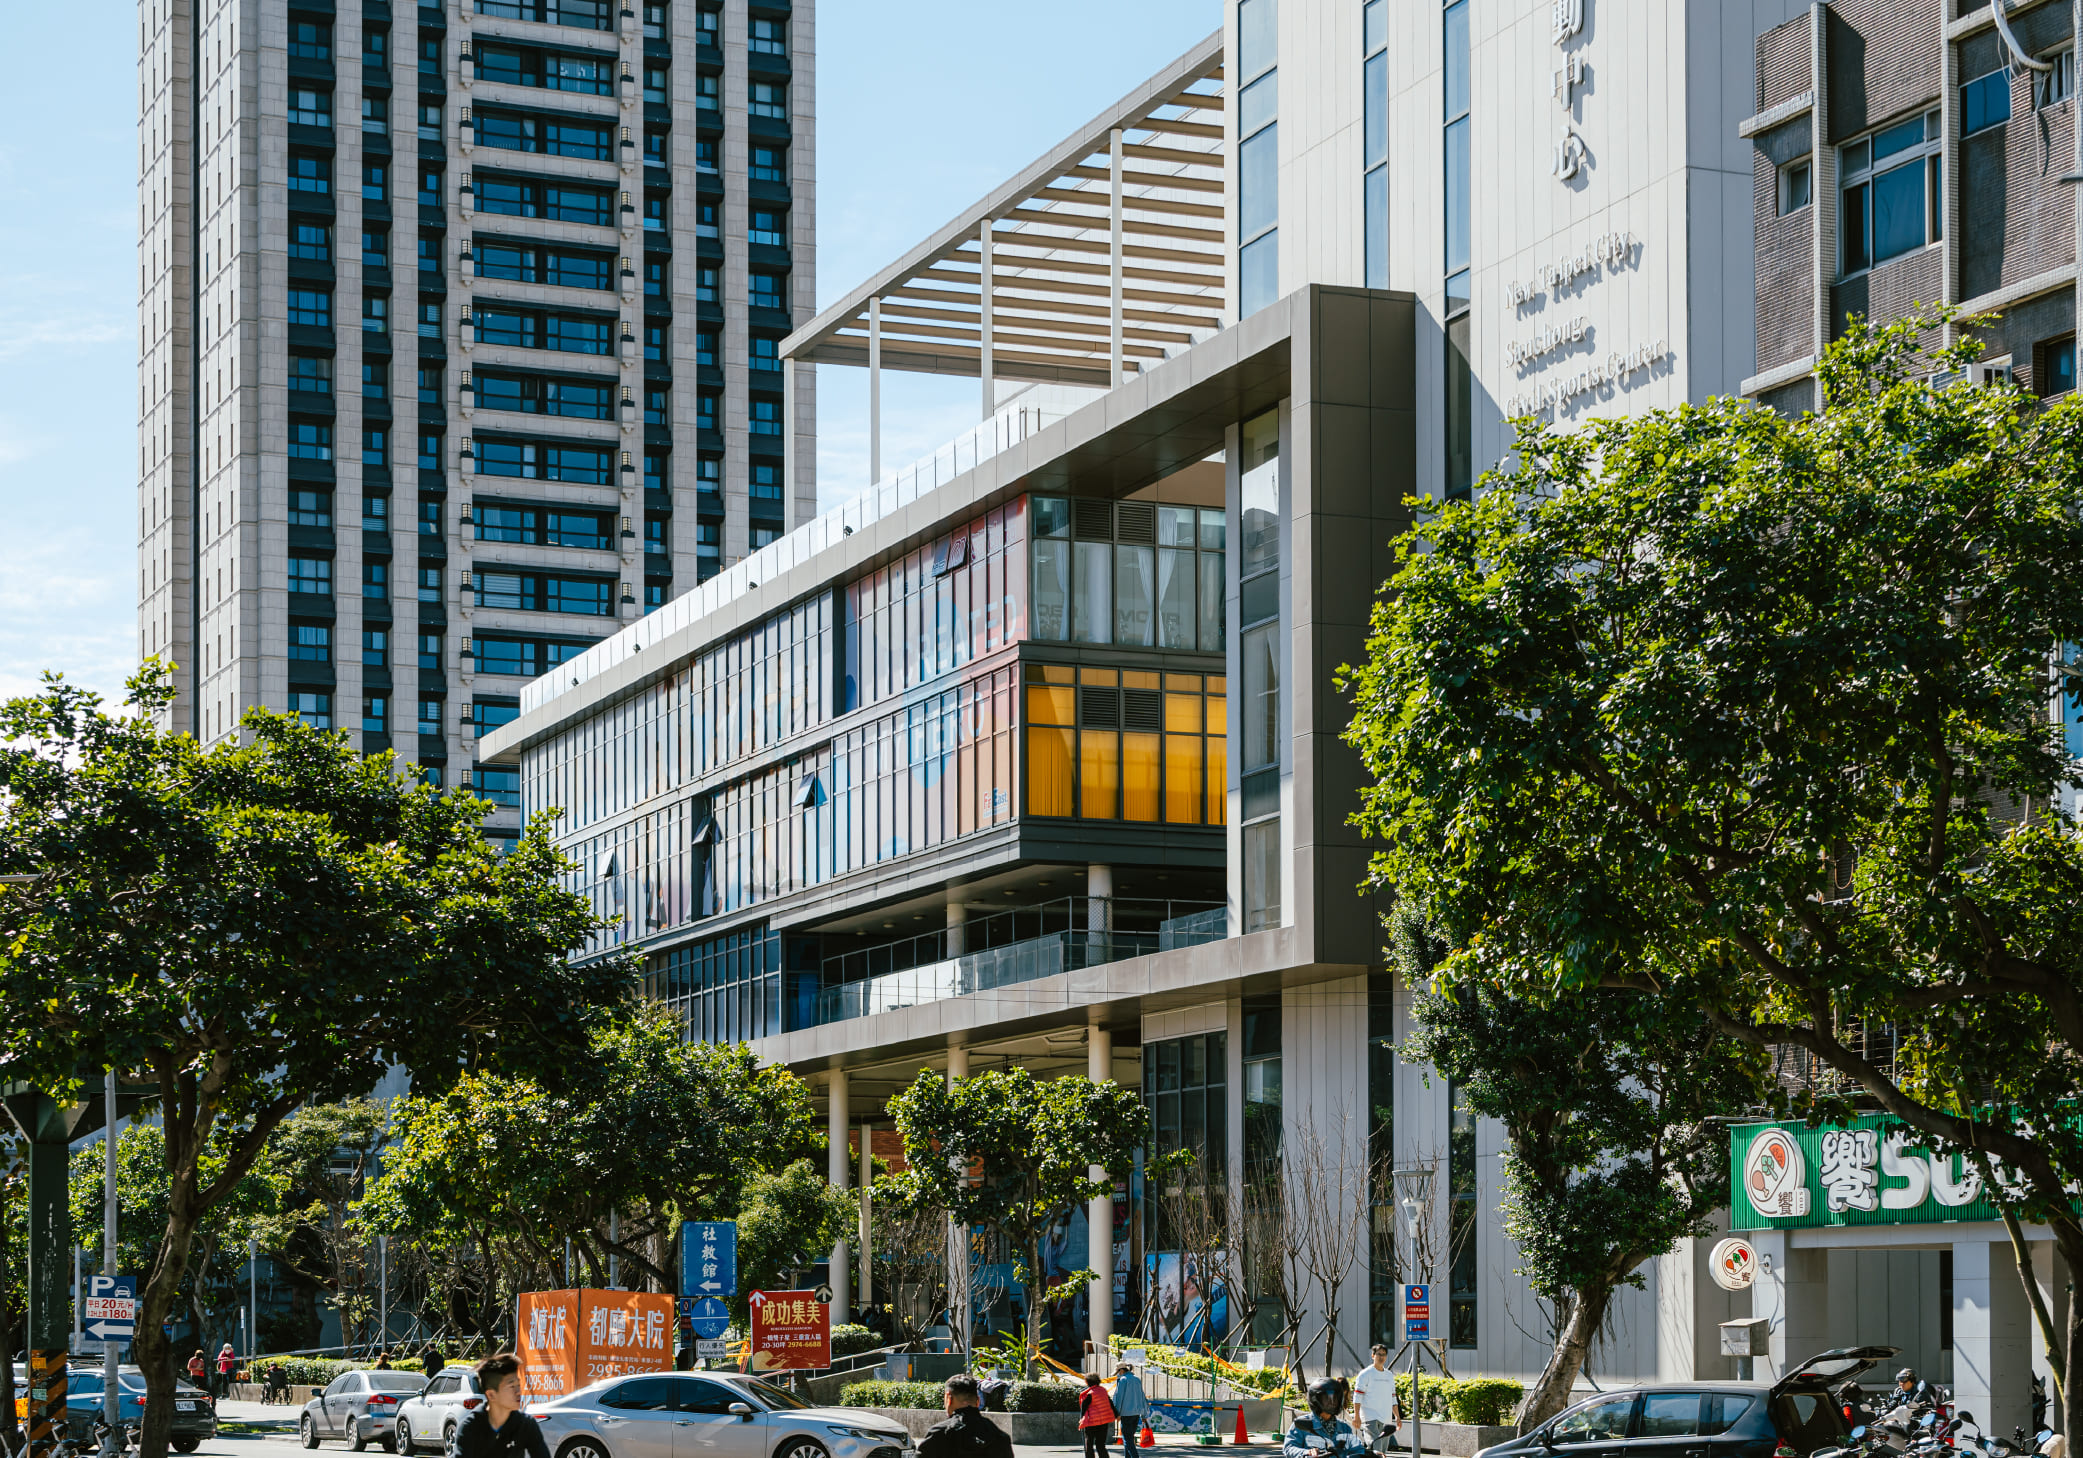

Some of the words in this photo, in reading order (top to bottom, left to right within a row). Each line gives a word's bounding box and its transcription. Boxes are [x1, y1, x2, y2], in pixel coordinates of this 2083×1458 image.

[1505, 280, 1536, 310] New
[1538, 243, 1591, 289] Taipei
[1594, 231, 1632, 263] City
[1505, 315, 1585, 368] Sanchong
[1505, 384, 1543, 421] Civil
[1547, 364, 1601, 408] Sports
[1605, 338, 1663, 380] Center
[898, 595, 1018, 682] CREATED
[912, 690, 986, 757] HERO
[1777, 1191, 1793, 1216] 饗
[701, 1226, 718, 1278] 社教館
[91, 1276, 115, 1297] P
[588, 1305, 665, 1350] 都廳大院
[761, 1300, 821, 1326] 成功集美
[523, 1374, 564, 1391] 2995-8666
